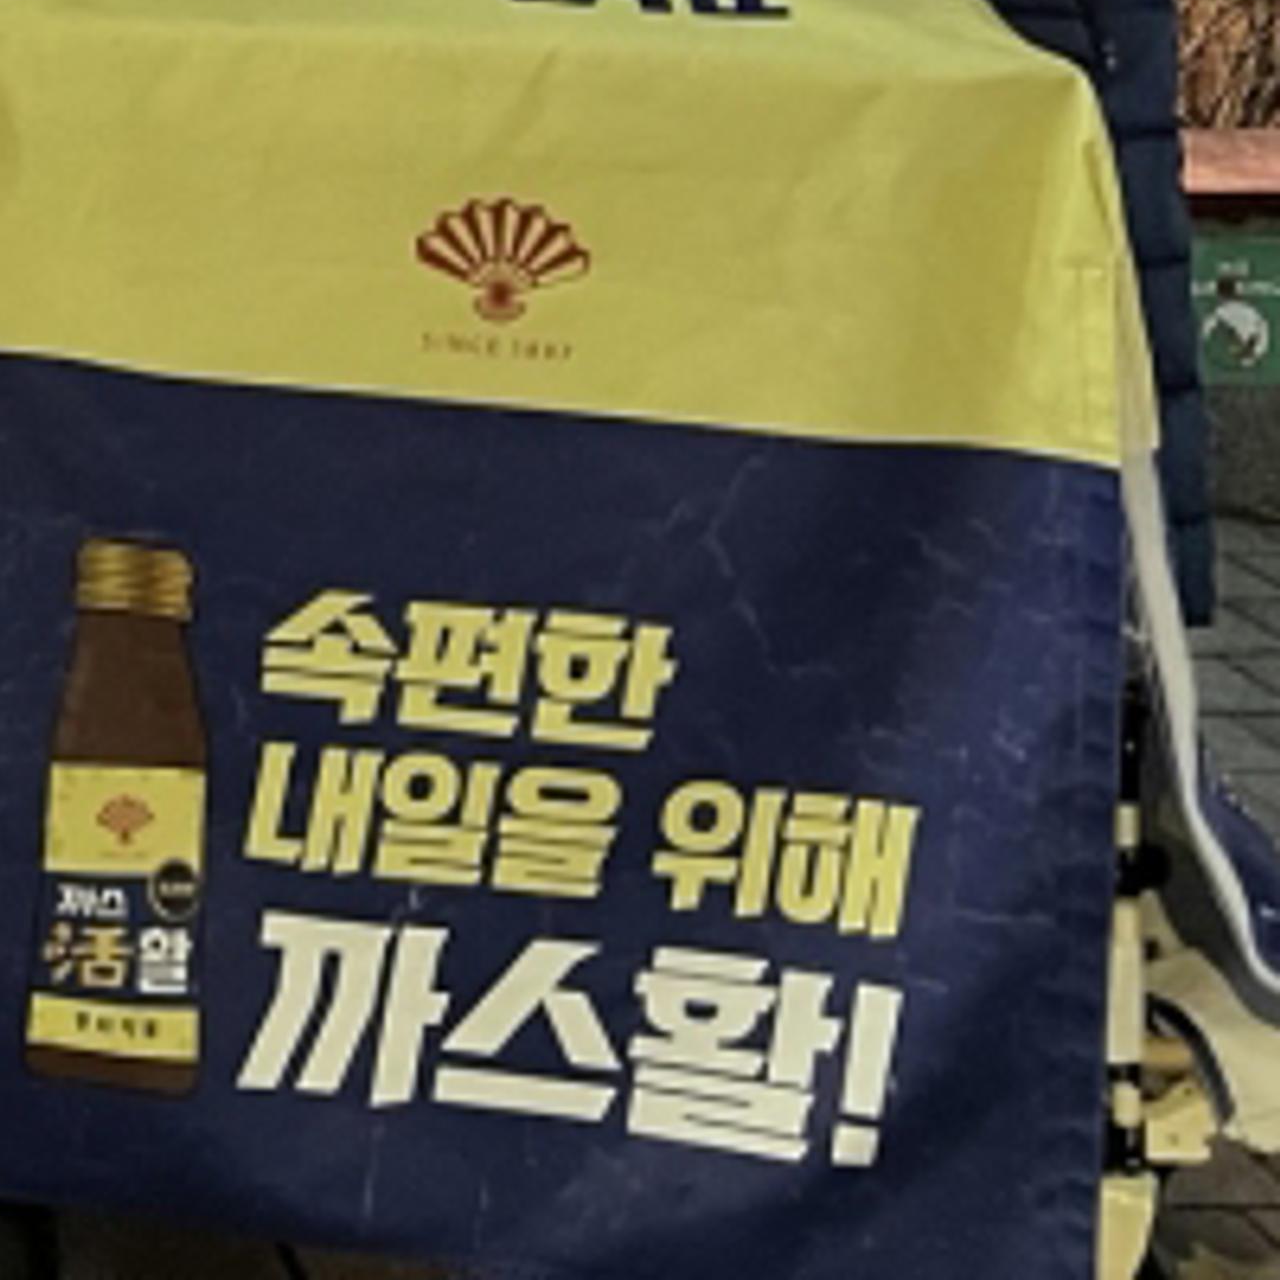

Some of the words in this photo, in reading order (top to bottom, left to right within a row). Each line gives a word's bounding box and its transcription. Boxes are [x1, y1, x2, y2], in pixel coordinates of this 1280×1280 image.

[262, 589, 678, 751] 속편한
[245, 742, 622, 899] 내일을
[652, 778, 919, 940] 위해
[237, 909, 904, 1169] 까스활!
